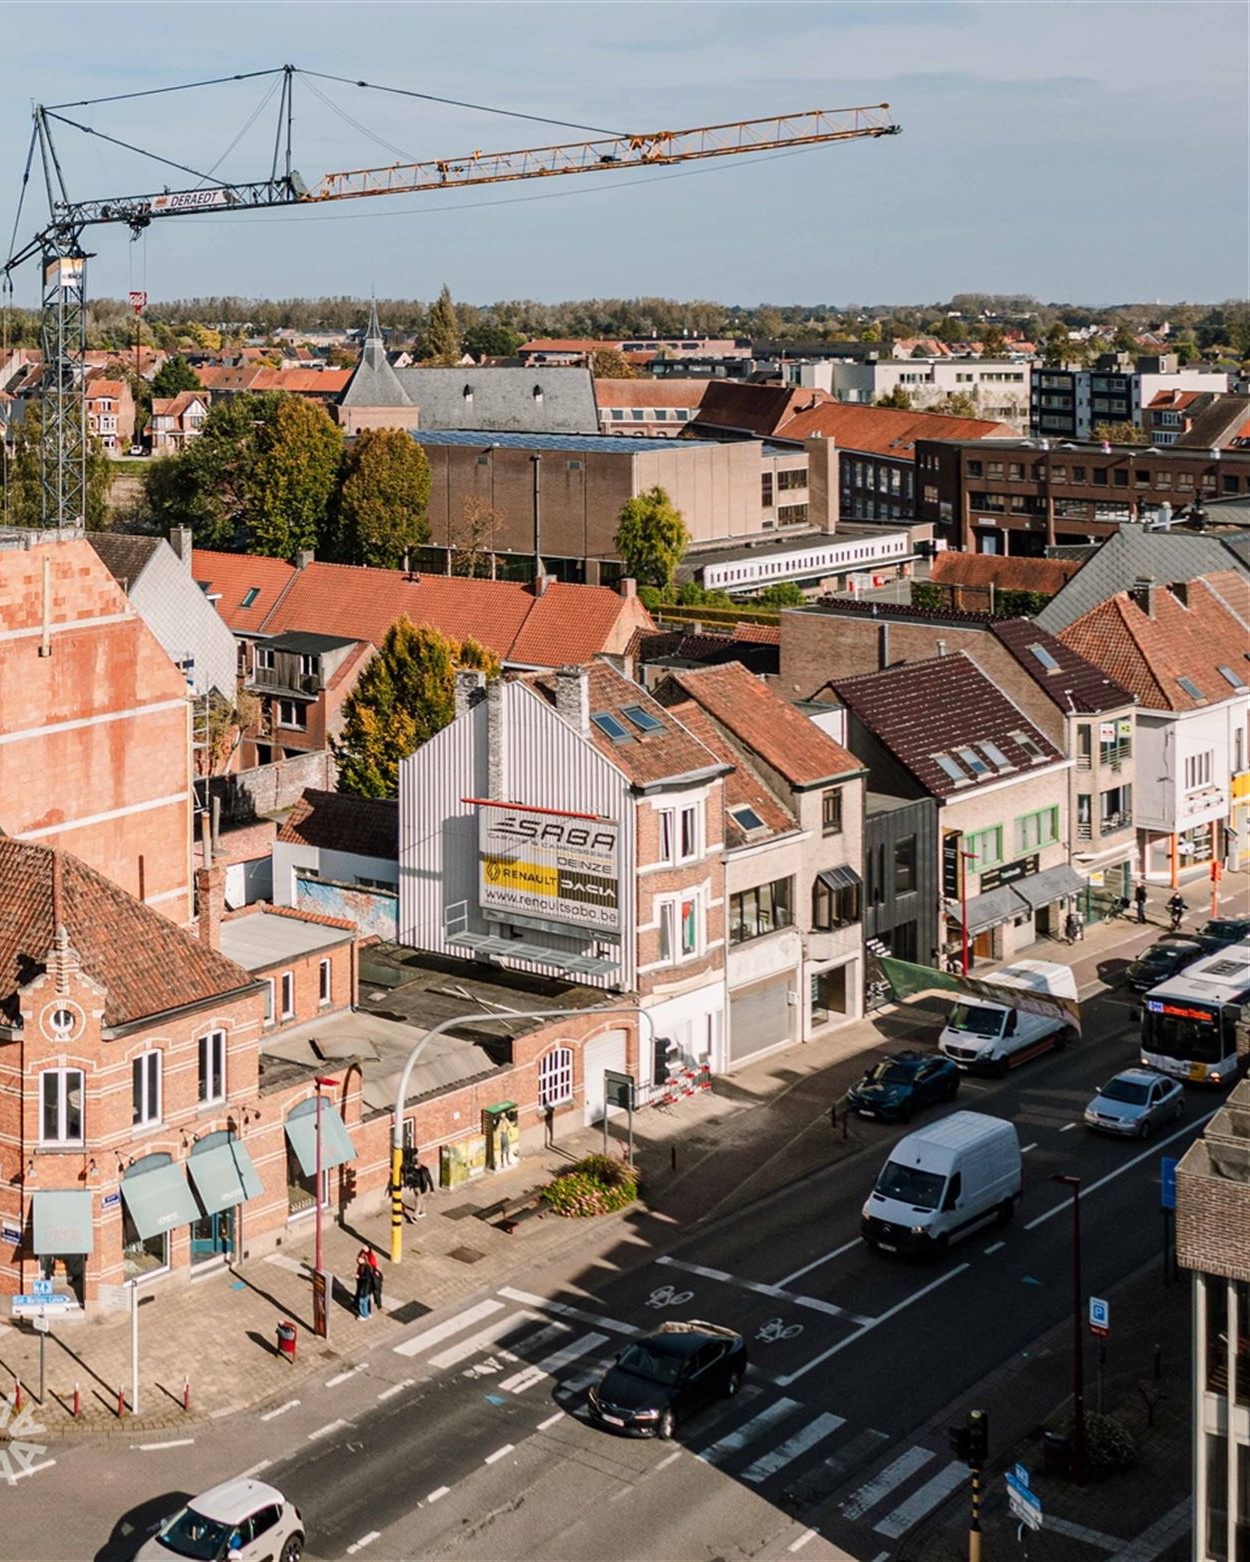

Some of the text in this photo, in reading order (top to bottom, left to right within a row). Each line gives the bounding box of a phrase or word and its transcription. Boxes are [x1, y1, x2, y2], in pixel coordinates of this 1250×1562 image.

[170, 192, 218, 207] DERAEDT
[502, 817, 616, 851] SABA
[557, 856, 613, 874] DEINZE
[502, 867, 558, 886] RENAULT
[560, 878, 617, 898] DACIA
[485, 889, 617, 923] www.renaultsaba.be
